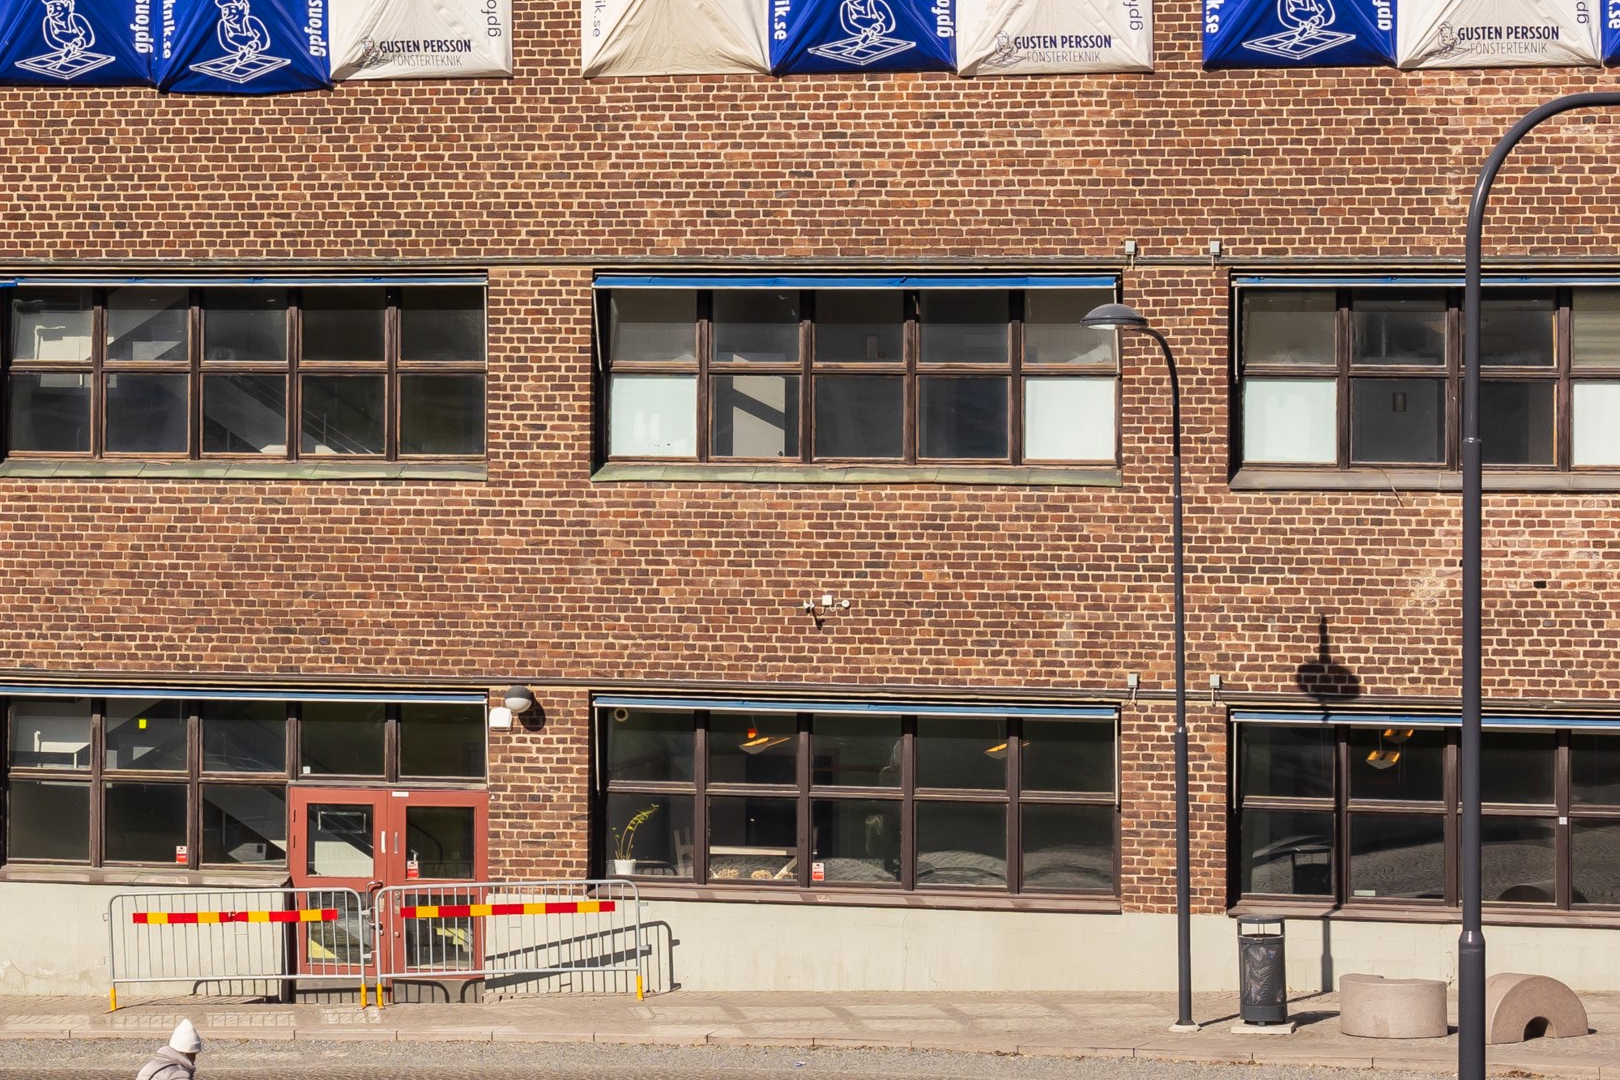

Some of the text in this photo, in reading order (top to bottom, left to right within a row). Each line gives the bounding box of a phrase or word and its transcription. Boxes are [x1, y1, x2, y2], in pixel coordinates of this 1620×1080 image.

[1457, 25, 1559, 41] GUSTEN PERSSON
[380, 39, 472, 53] GUSTEN PERSSON
[1014, 34, 1112, 50] GUSTEN PERSSON
